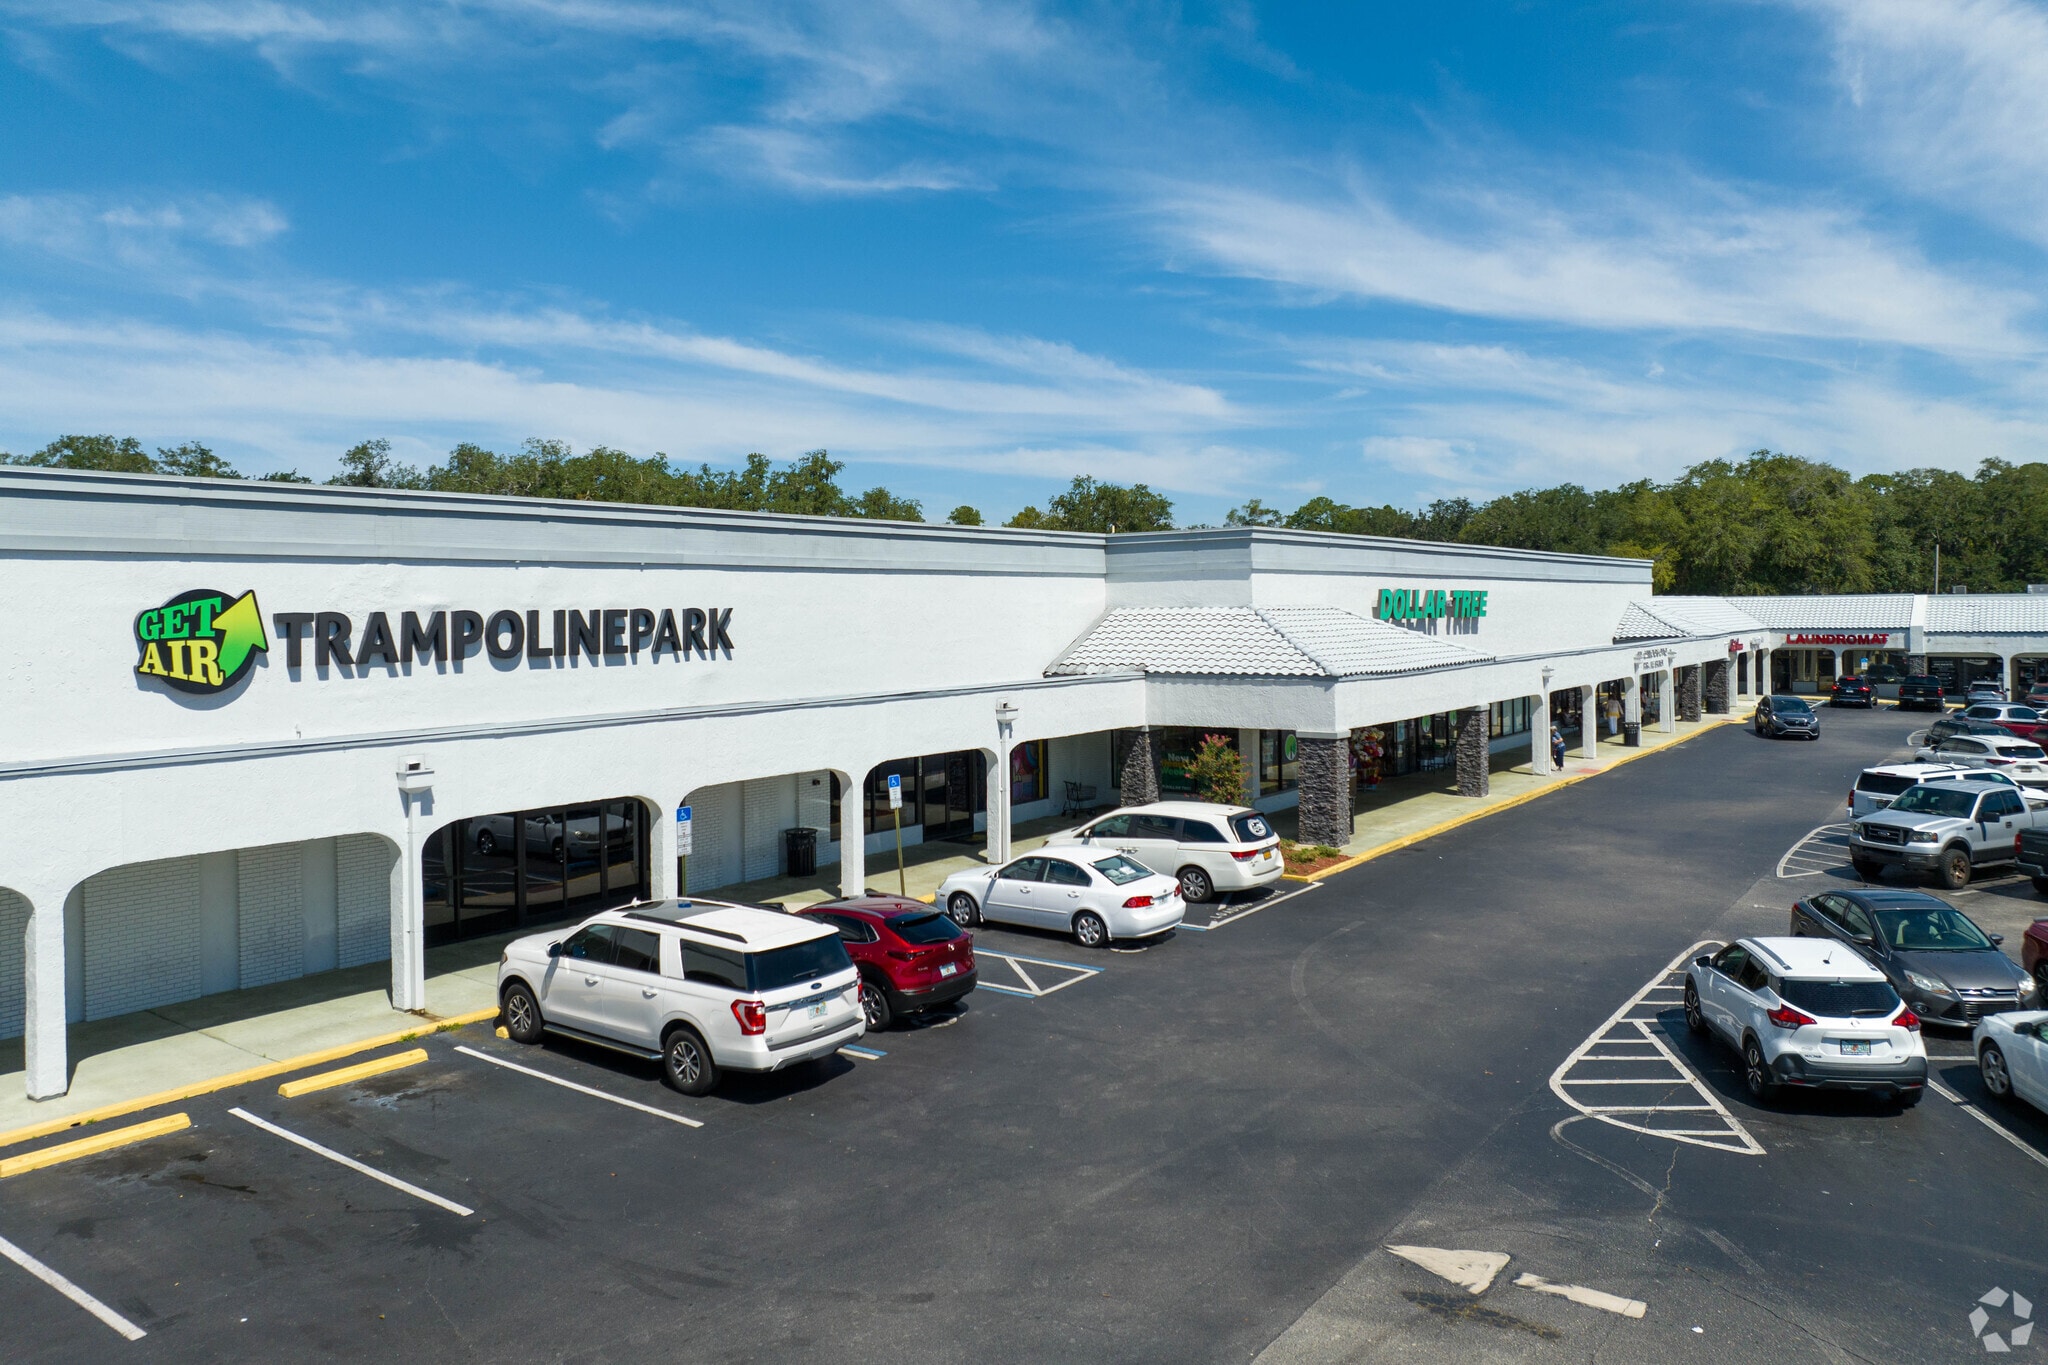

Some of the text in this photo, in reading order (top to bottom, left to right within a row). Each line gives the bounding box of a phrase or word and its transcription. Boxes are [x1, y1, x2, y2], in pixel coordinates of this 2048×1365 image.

[138, 596, 222, 641] GET
[1379, 588, 1489, 621] DOLLAR TREE
[1786, 633, 1890, 645] LAUNDROMAT
[138, 639, 225, 687] AIR
